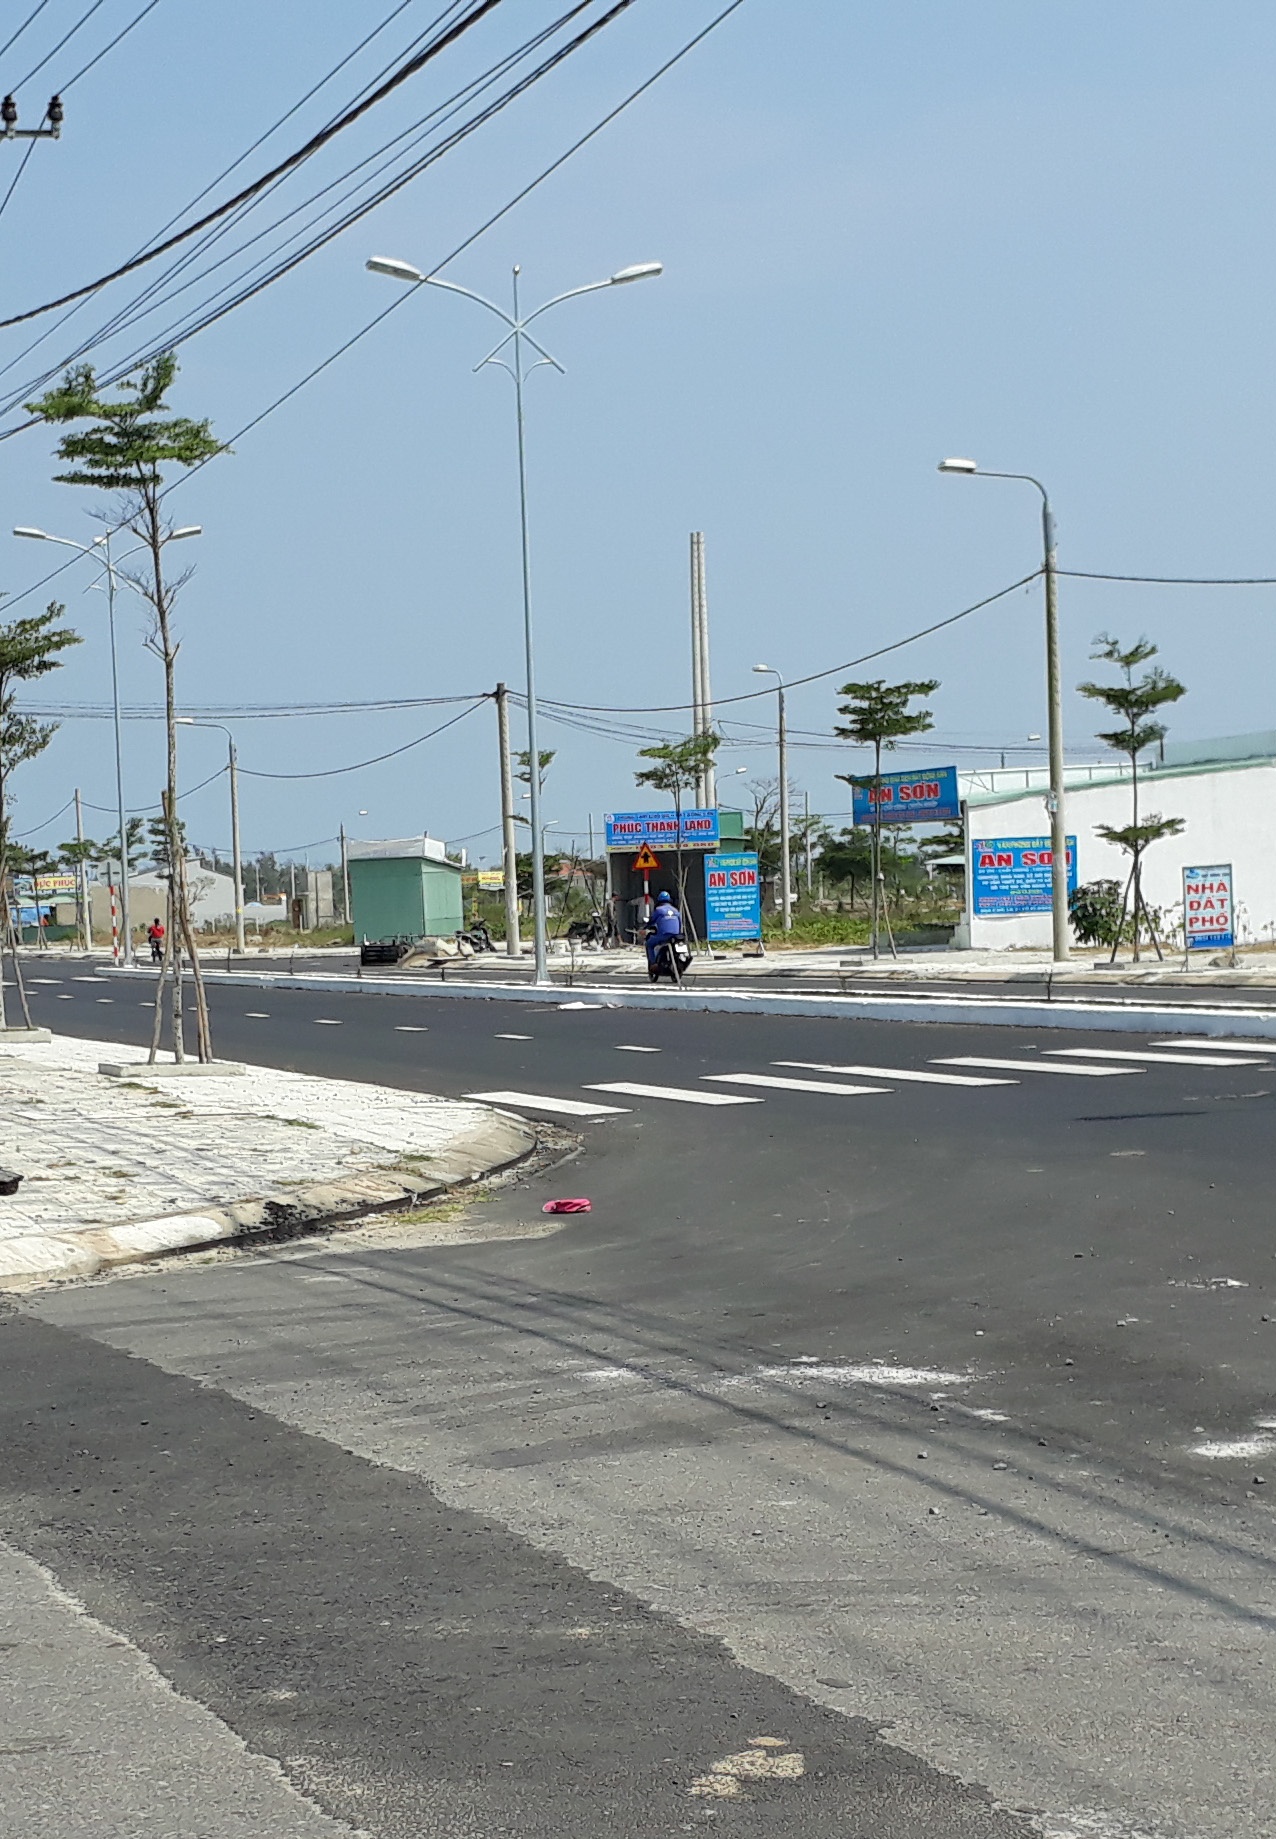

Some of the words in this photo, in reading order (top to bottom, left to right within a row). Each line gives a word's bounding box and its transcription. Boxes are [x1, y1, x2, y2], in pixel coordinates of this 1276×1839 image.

[899, 781, 940, 802] SƠN
[684, 819, 712, 831] LAND
[979, 853, 1013, 868] AN
[709, 872, 726, 887] AN
[729, 868, 756, 887] SƠN
[1186, 879, 1229, 896] NHÀ
[1189, 895, 1229, 912] ĐẤT
[1189, 910, 1229, 928] PHỐ
